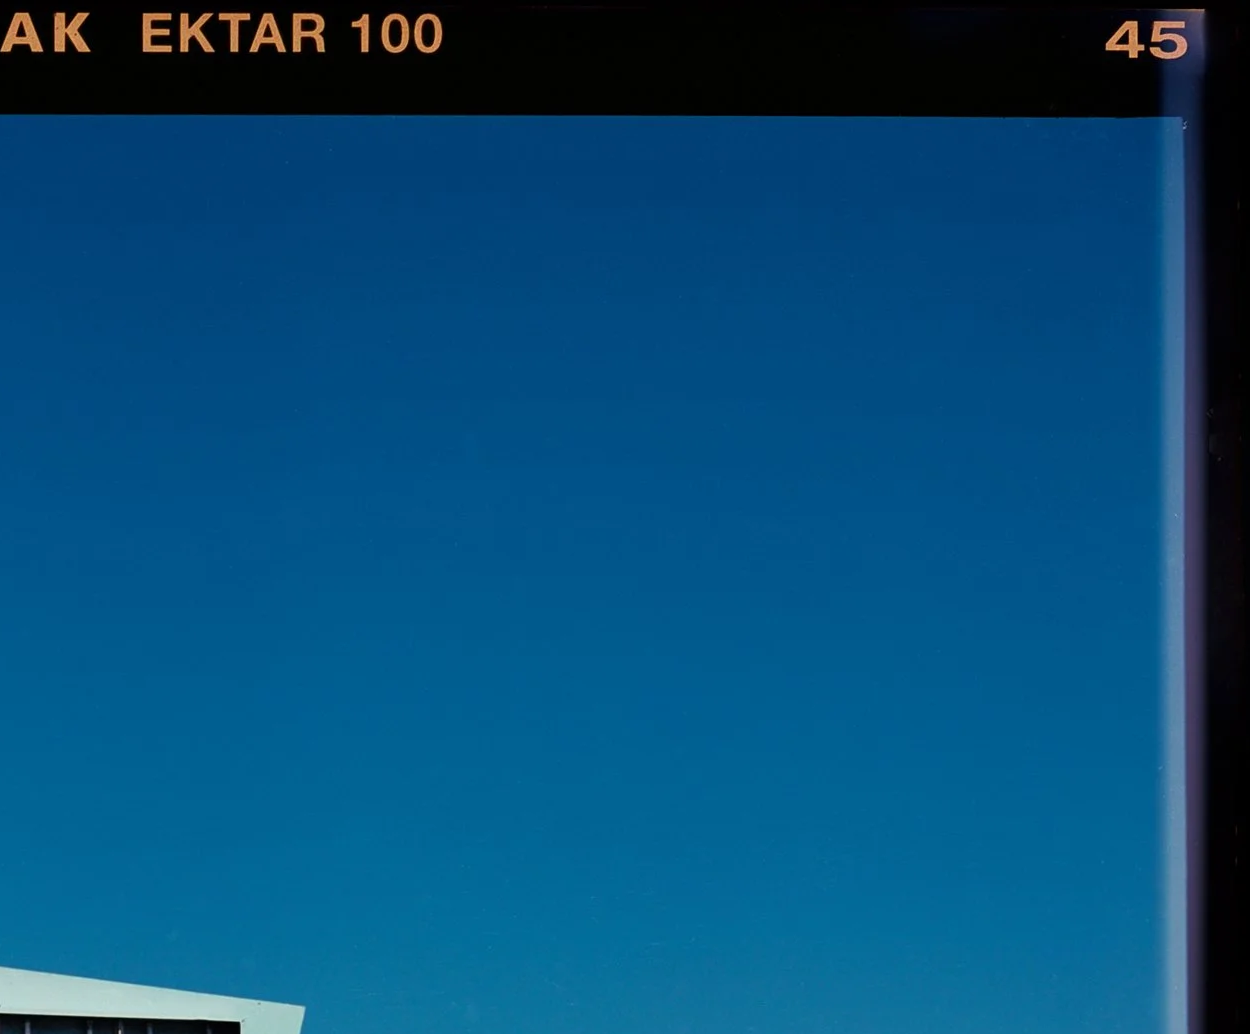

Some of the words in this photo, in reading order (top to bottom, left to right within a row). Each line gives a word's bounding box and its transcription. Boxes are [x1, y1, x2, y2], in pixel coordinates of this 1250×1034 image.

[142, 12, 327, 53] EKTAR
[351, 13, 443, 54] 100
[1105, 20, 1188, 60] 45
